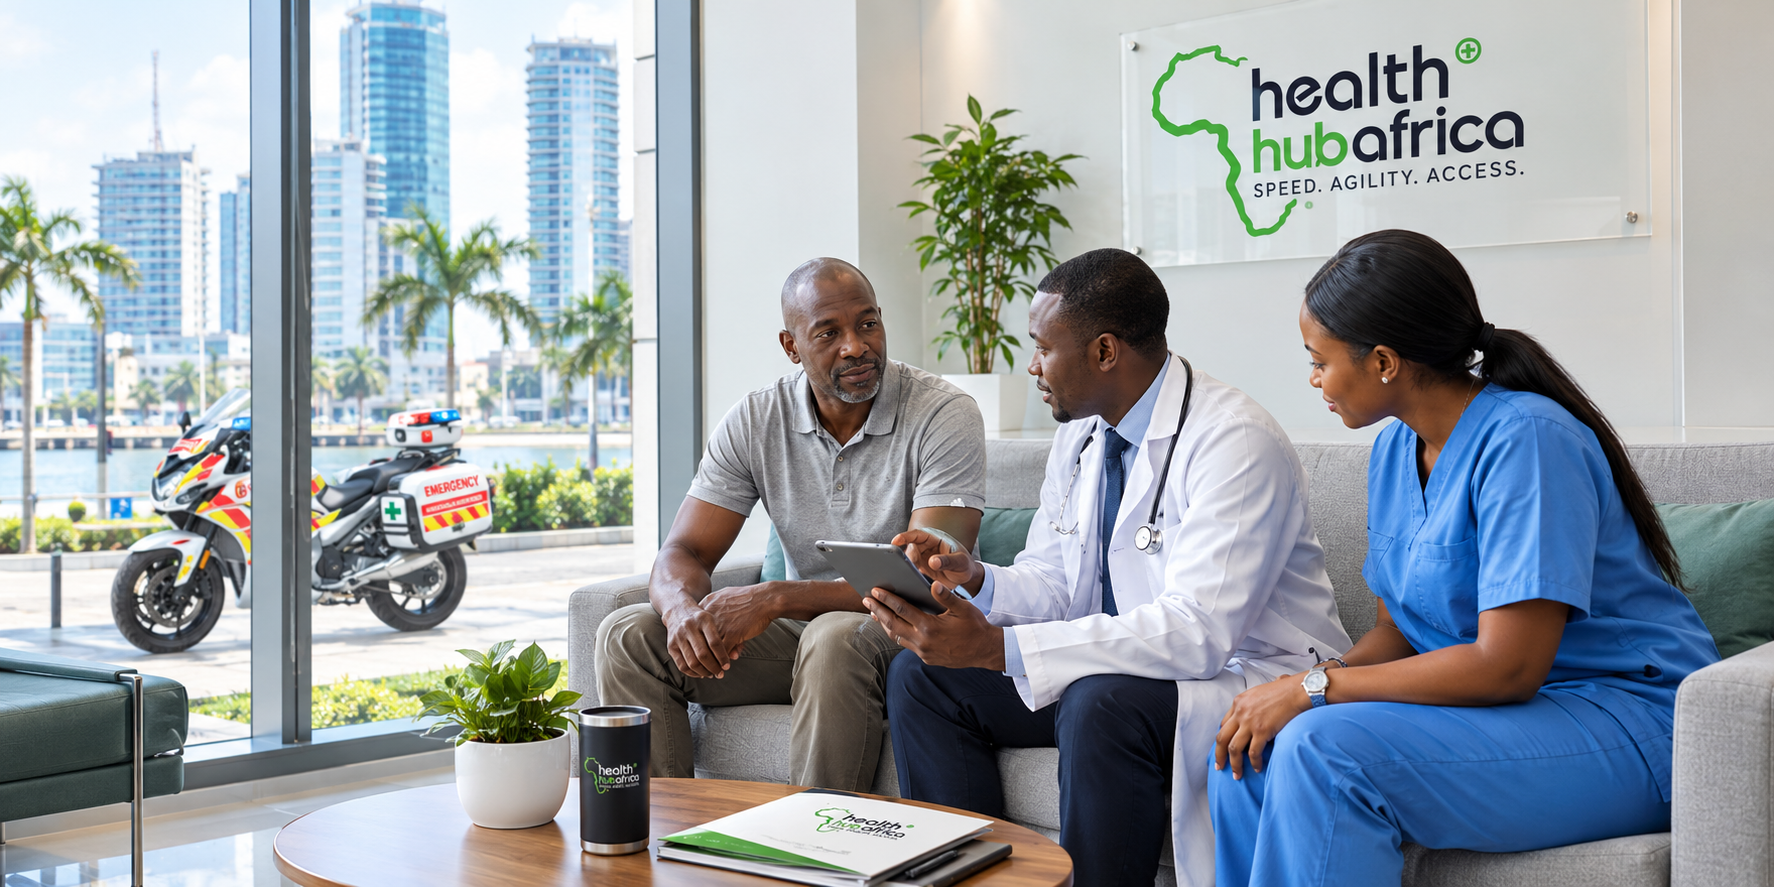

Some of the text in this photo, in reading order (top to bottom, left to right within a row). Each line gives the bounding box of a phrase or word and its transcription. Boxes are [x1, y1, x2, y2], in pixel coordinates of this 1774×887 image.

[1252, 44, 1450, 122] health
[1252, 105, 1525, 174] hubafrica
[1253, 160, 1525, 199] SPEED. AGILITY. ACCESS.
[424, 475, 479, 497] EMERGENCY
